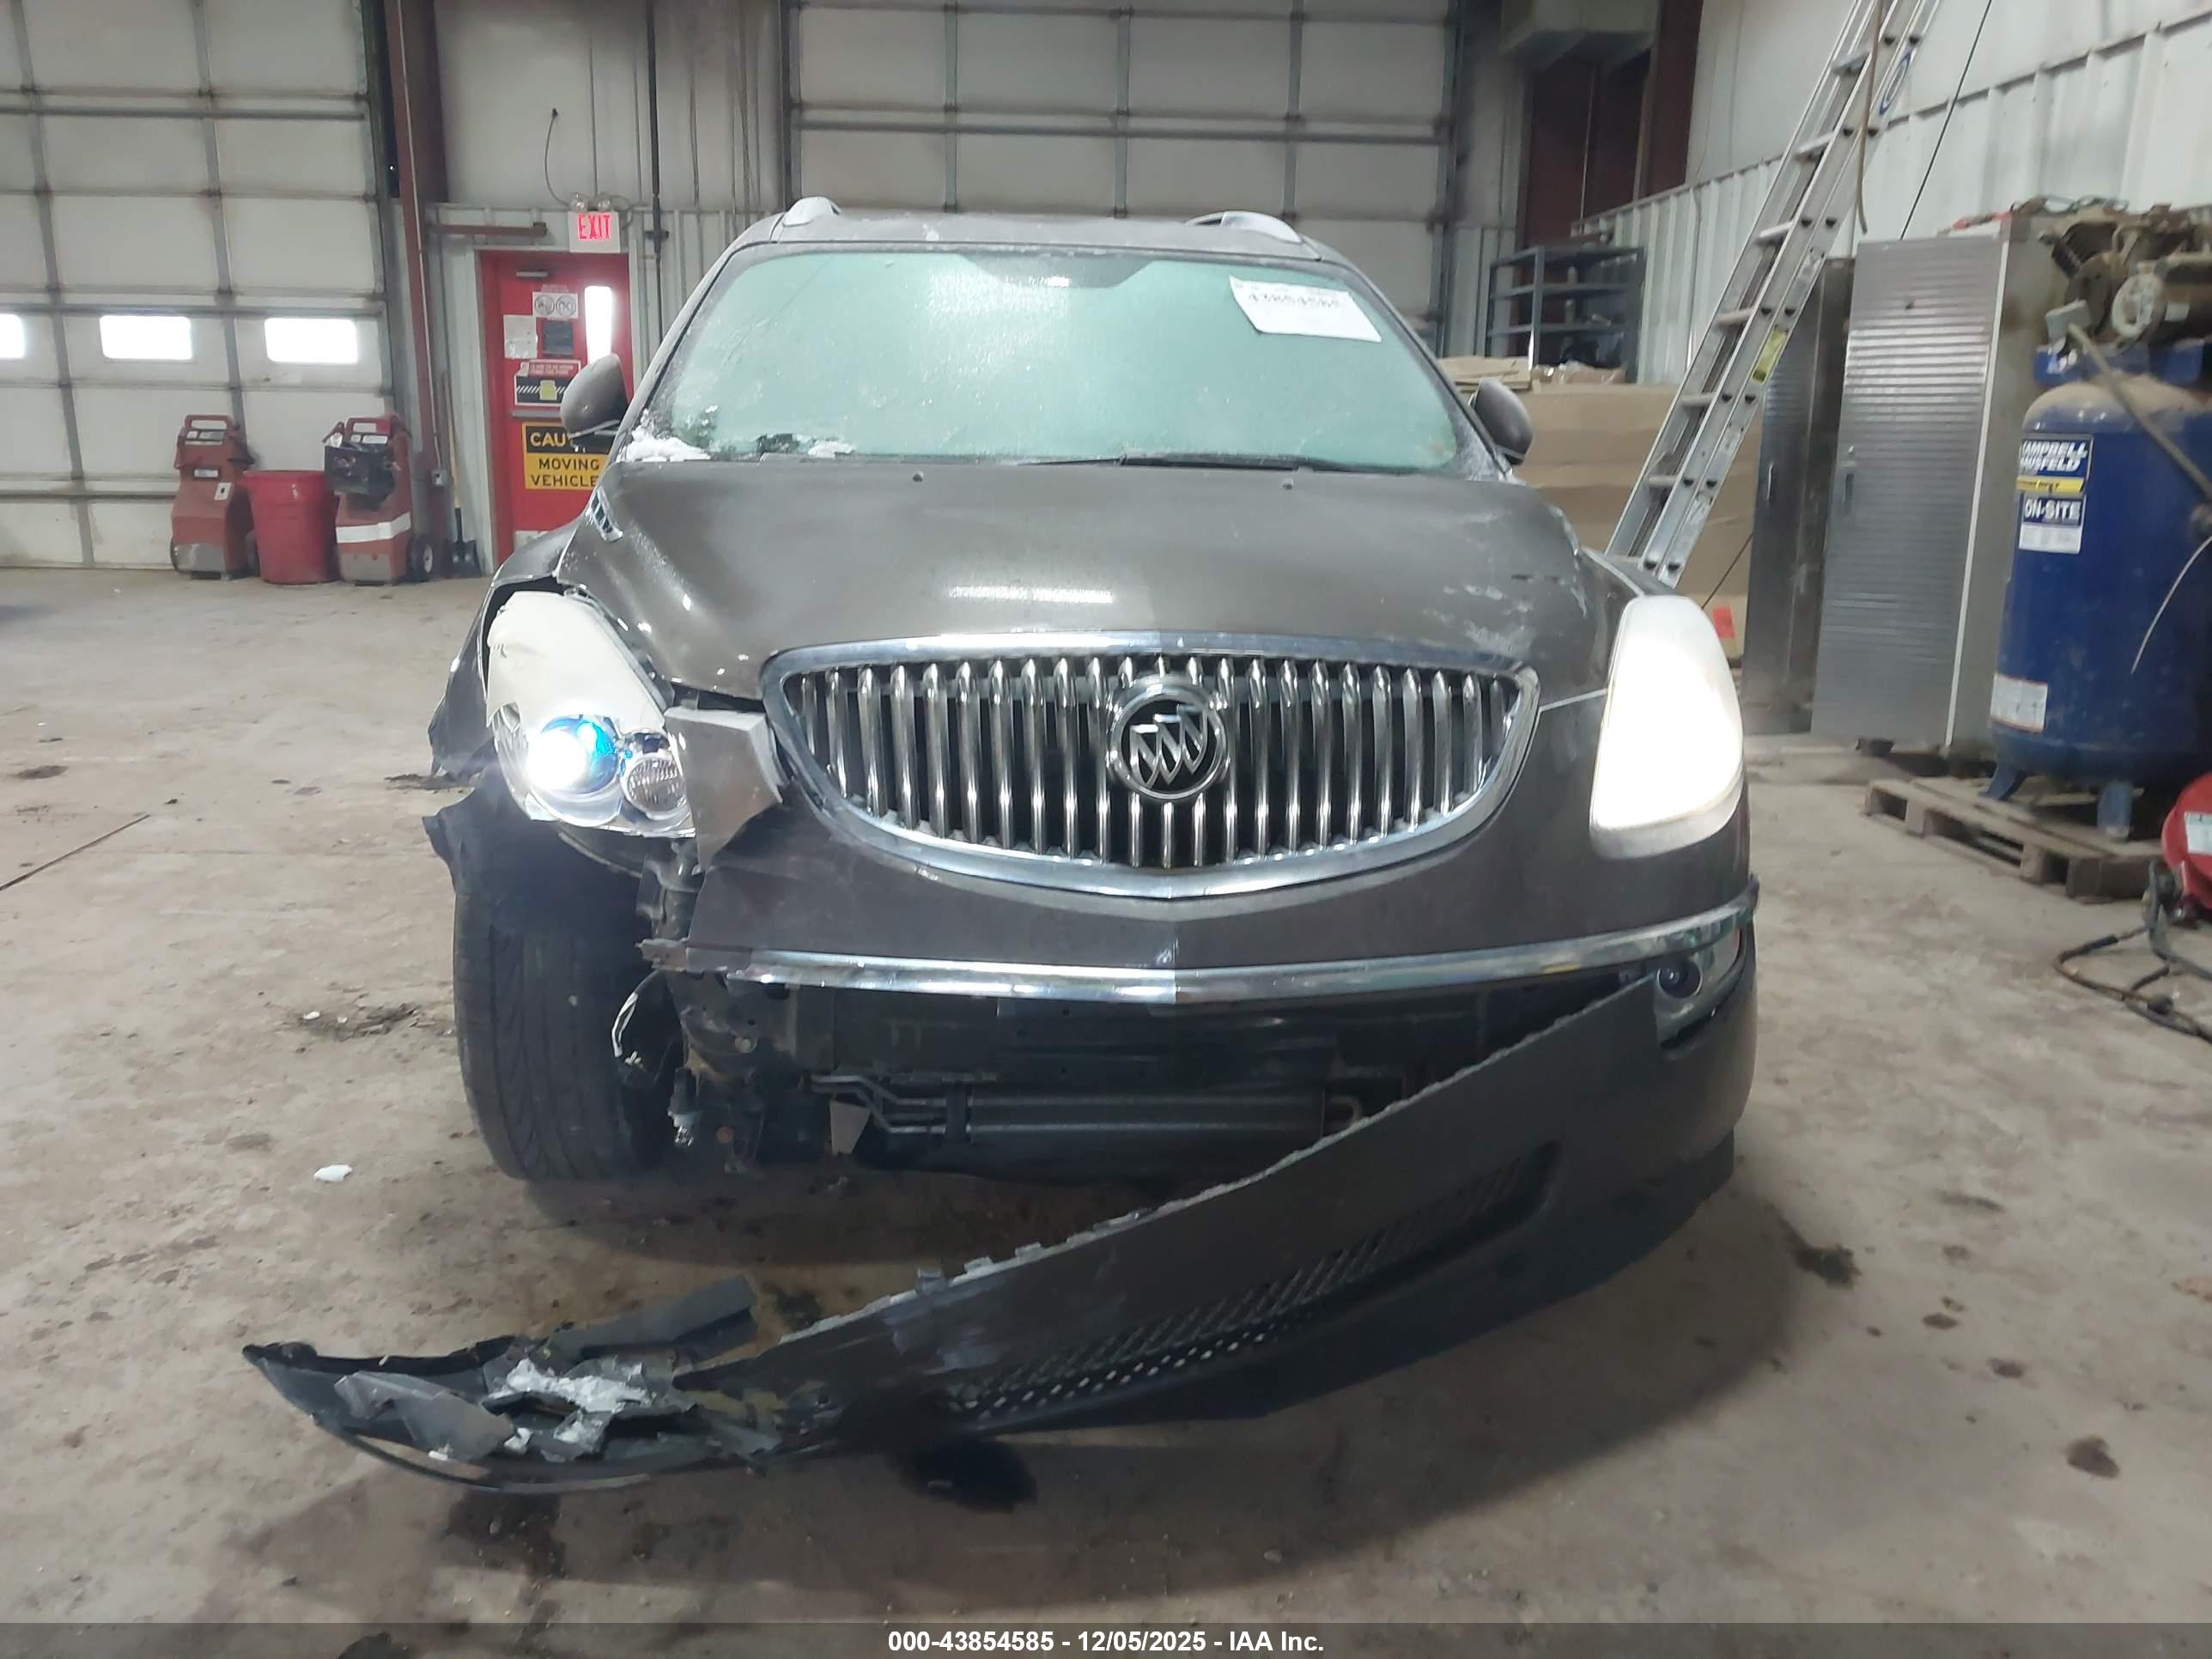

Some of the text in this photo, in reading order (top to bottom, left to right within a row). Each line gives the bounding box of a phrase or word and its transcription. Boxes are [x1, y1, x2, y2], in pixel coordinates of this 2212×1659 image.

[577, 212, 611, 240] EXIT
[530, 432, 570, 447] CAU
[538, 458, 600, 471] MOVING
